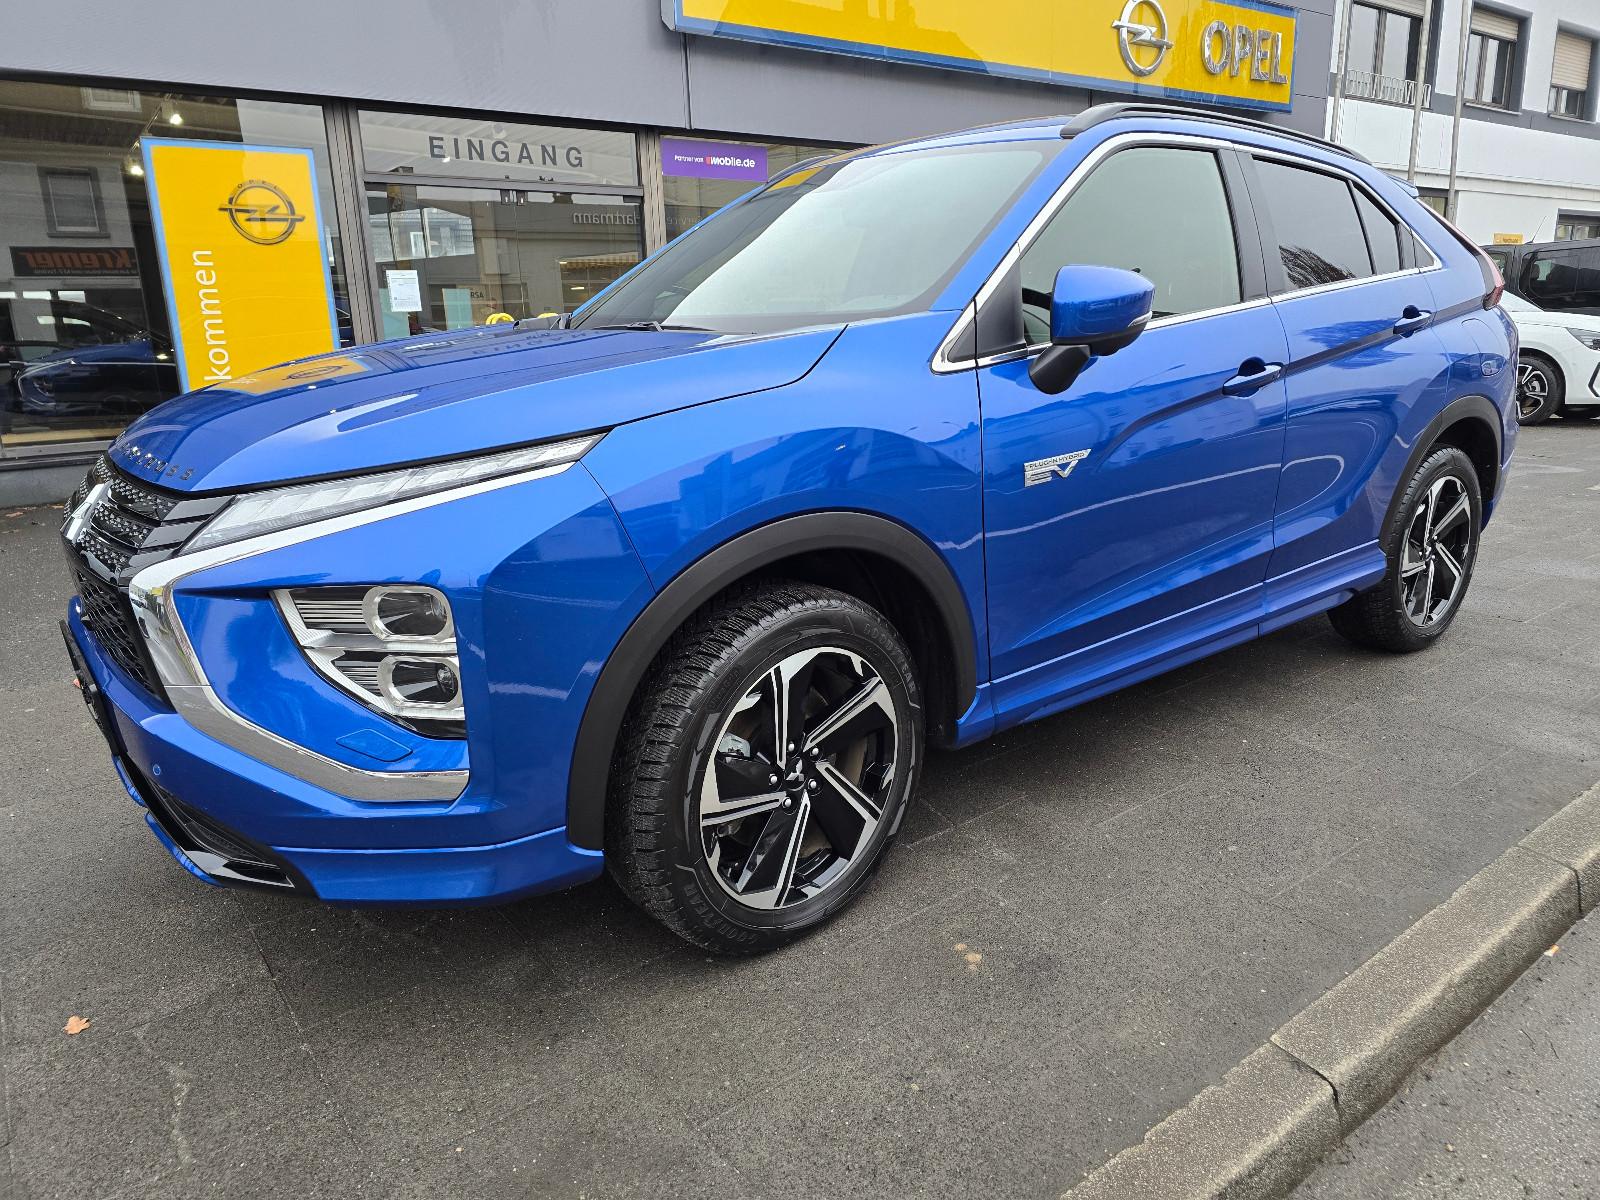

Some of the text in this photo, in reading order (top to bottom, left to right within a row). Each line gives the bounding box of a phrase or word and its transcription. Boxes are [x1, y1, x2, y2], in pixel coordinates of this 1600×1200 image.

[1201, 19, 1288, 84] OPEL
[428, 135, 583, 168] EINGANG
[674, 154, 694, 163] Partner
[192, 250, 232, 381] kommen
[1059, 451, 1085, 463] HYBRID
[1024, 460, 1079, 487] EV
